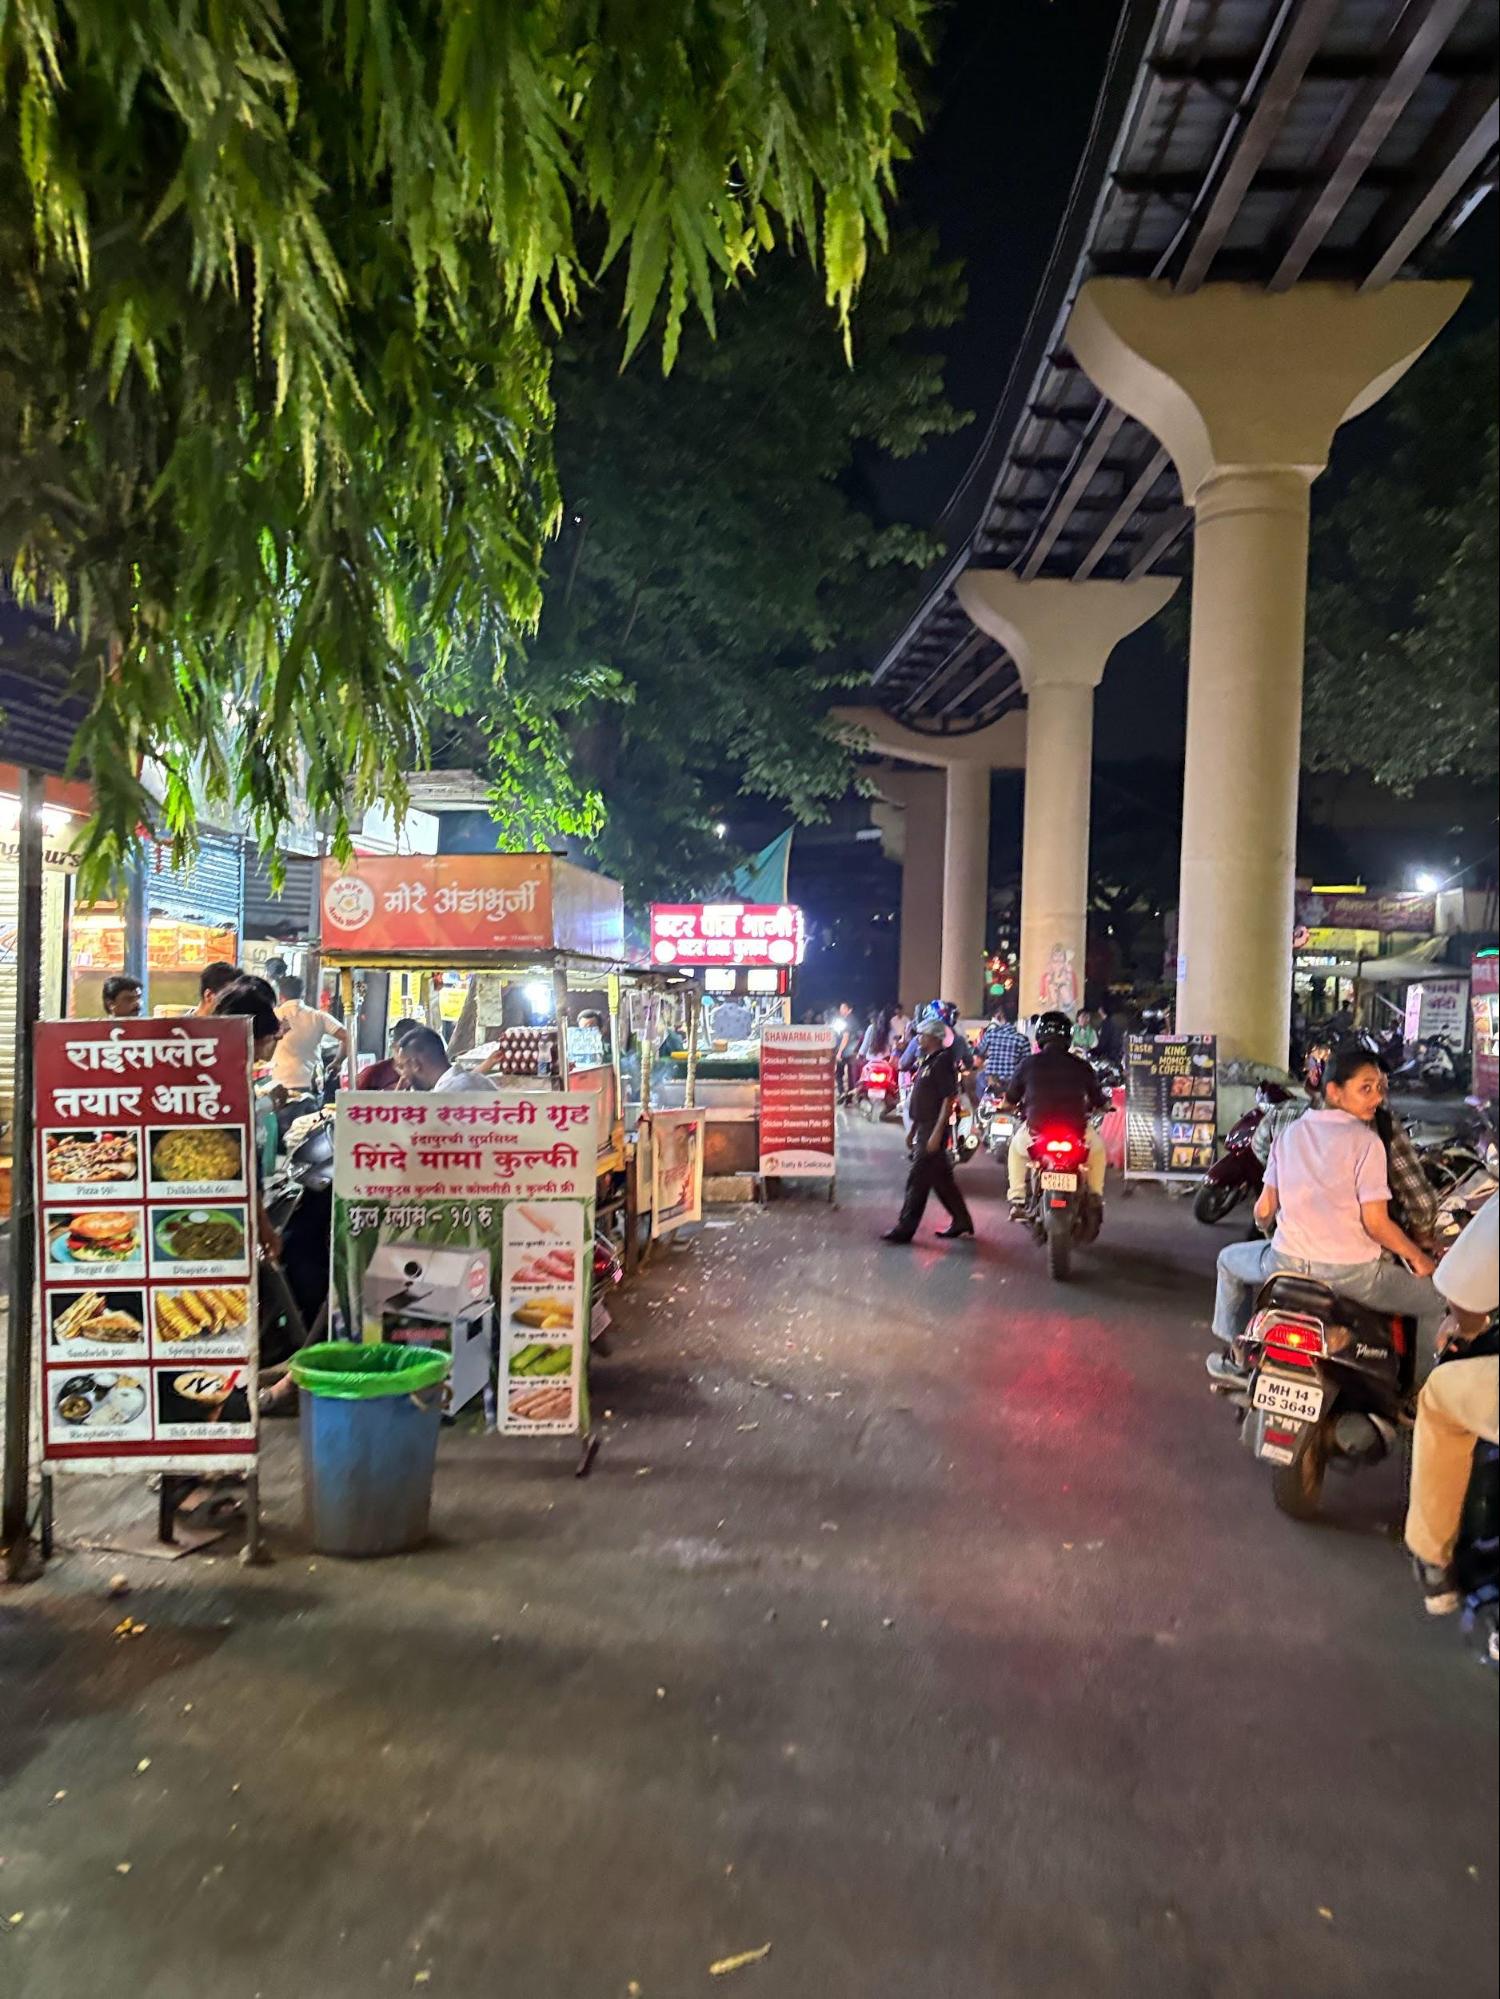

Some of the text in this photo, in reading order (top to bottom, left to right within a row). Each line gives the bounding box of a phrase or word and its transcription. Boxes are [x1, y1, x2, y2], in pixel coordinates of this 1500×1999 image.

[383, 881, 428, 914] मोरे
[765, 1031, 811, 1042] SHAWARMA
[1129, 1035, 1143, 1043] The
[65, 1028, 219, 1073] राईसप्लेट
[1129, 1044, 1153, 1054] Taste
[1164, 1046, 1187, 1056] KING
[1159, 1056, 1192, 1066] MOMO'S
[1159, 1065, 1191, 1075] COFFEE
[52, 1073, 232, 1121] तयार आहे.
[347, 1101, 590, 1131] सणस रसवंती गृह
[352, 1142, 578, 1177] शिंदे मामा कुल्फी
[527, 1181, 557, 1198] कुल्फी
[349, 1205, 379, 1236] फुल
[1268, 1383, 1309, 1401] MH 14
[1257, 1393, 1316, 1416] DS 3649
